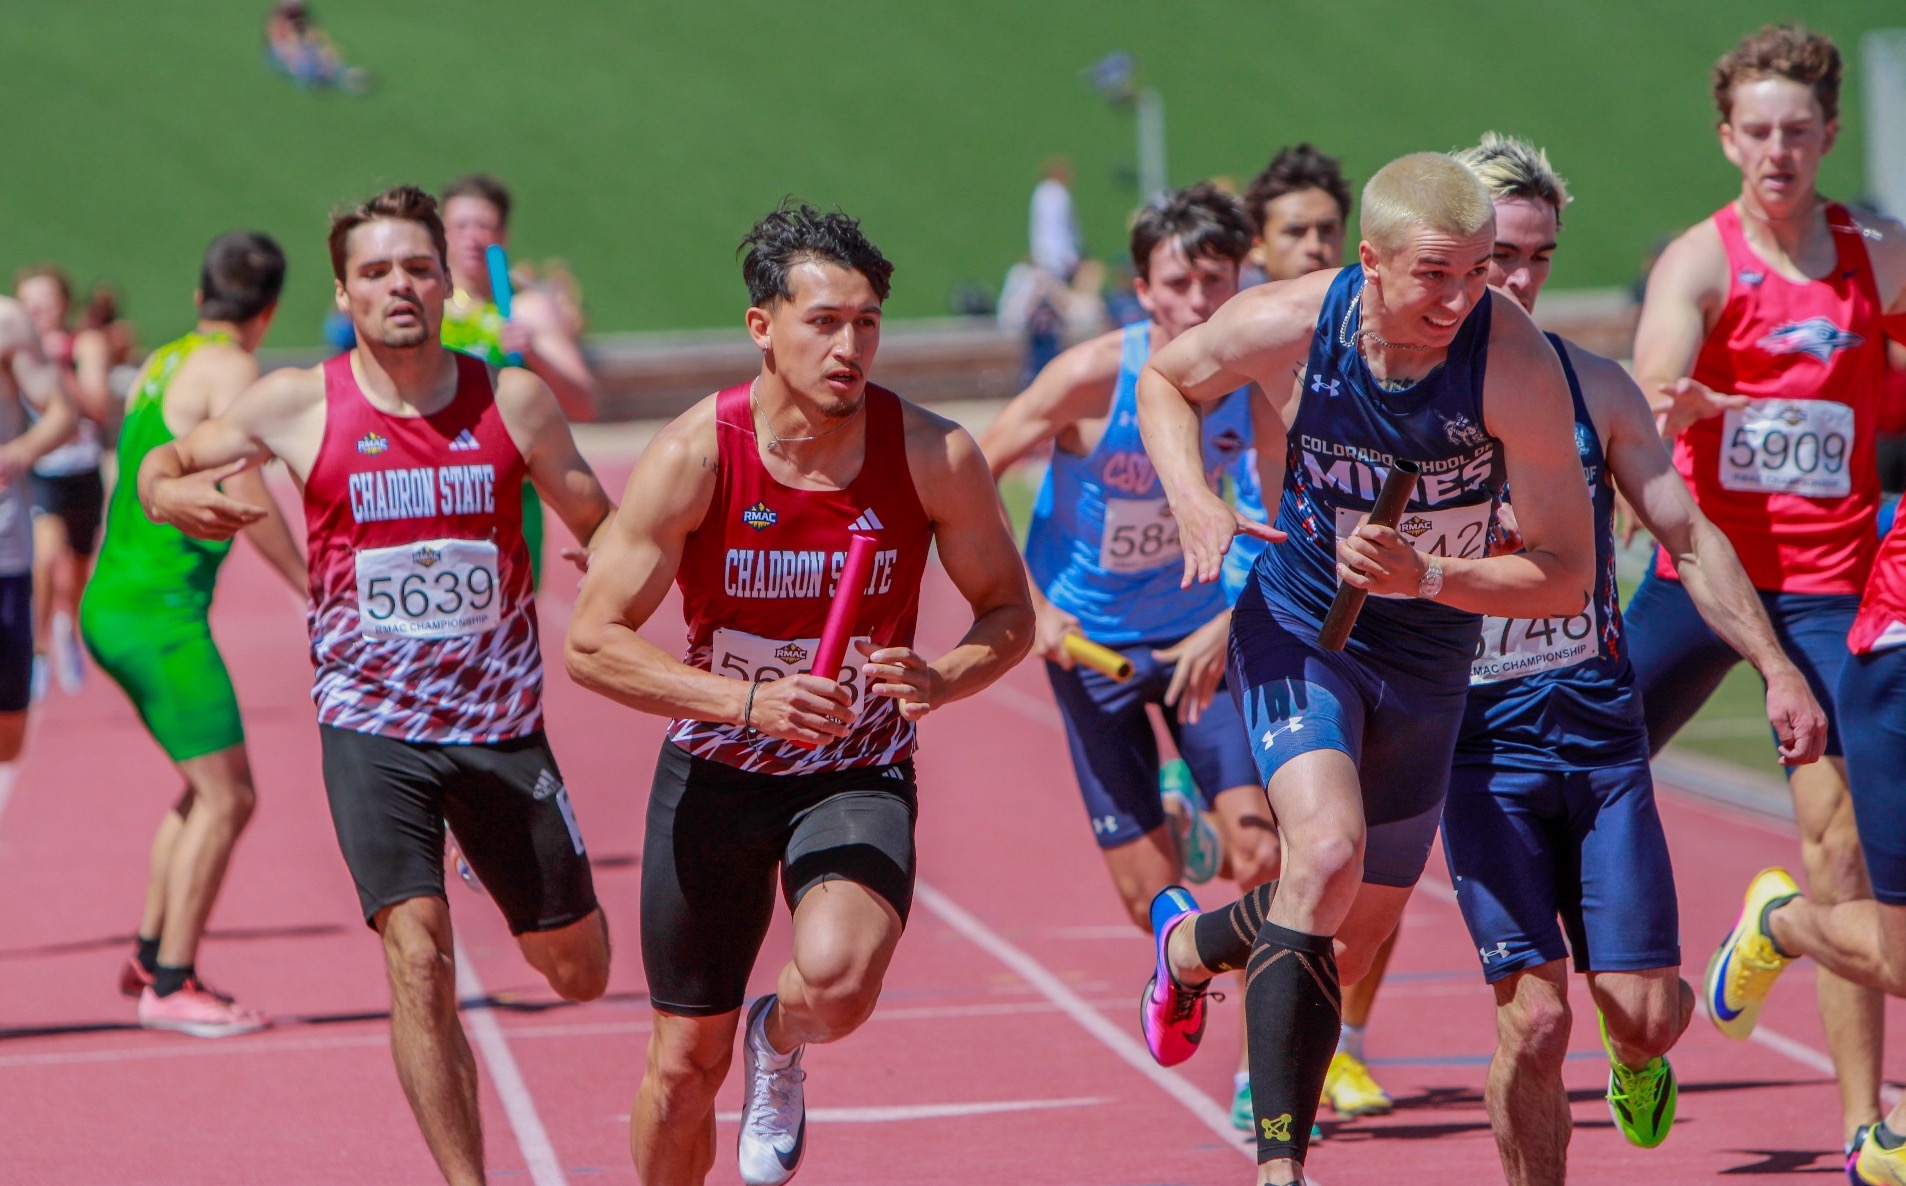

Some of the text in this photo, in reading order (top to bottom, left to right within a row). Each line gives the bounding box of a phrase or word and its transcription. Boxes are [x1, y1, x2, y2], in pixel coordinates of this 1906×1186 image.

[357, 439, 388, 453] RMAC
[1301, 434, 1393, 466] COLORADO
[1400, 457, 1470, 473] HOOL
[1729, 427, 1847, 474] 5909
[349, 464, 496, 524] CHADRON STATE
[743, 511, 776, 524] RMAC
[1401, 521, 1433, 532] RMAC
[724, 548, 898, 599] CHADRON STE
[366, 565, 494, 620] 5639
[375, 614, 489, 634] RMAC CHAMPIONSHIP
[776, 649, 807, 660] RMAC
[1470, 663, 1500, 677] MAC
[1502, 644, 1588, 672] CHAMPIONSHIP
